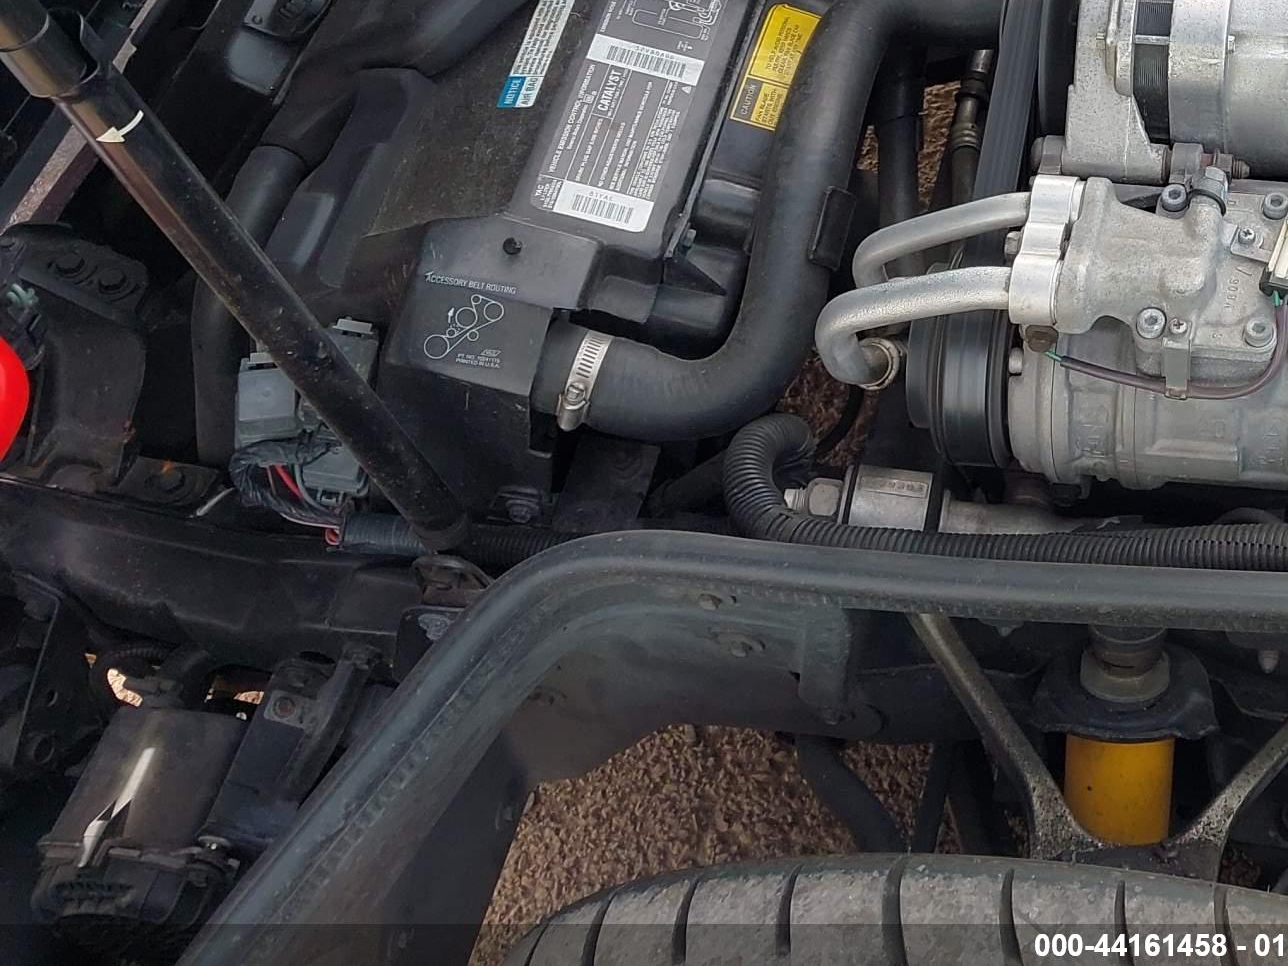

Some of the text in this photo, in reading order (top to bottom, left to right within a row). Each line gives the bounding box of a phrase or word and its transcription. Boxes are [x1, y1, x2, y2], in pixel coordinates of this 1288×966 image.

[597, 69, 622, 111] CATALYST
[740, 84, 757, 114] CAUTION
[426, 275, 516, 294] ACCESSORY BELT ROUTING
